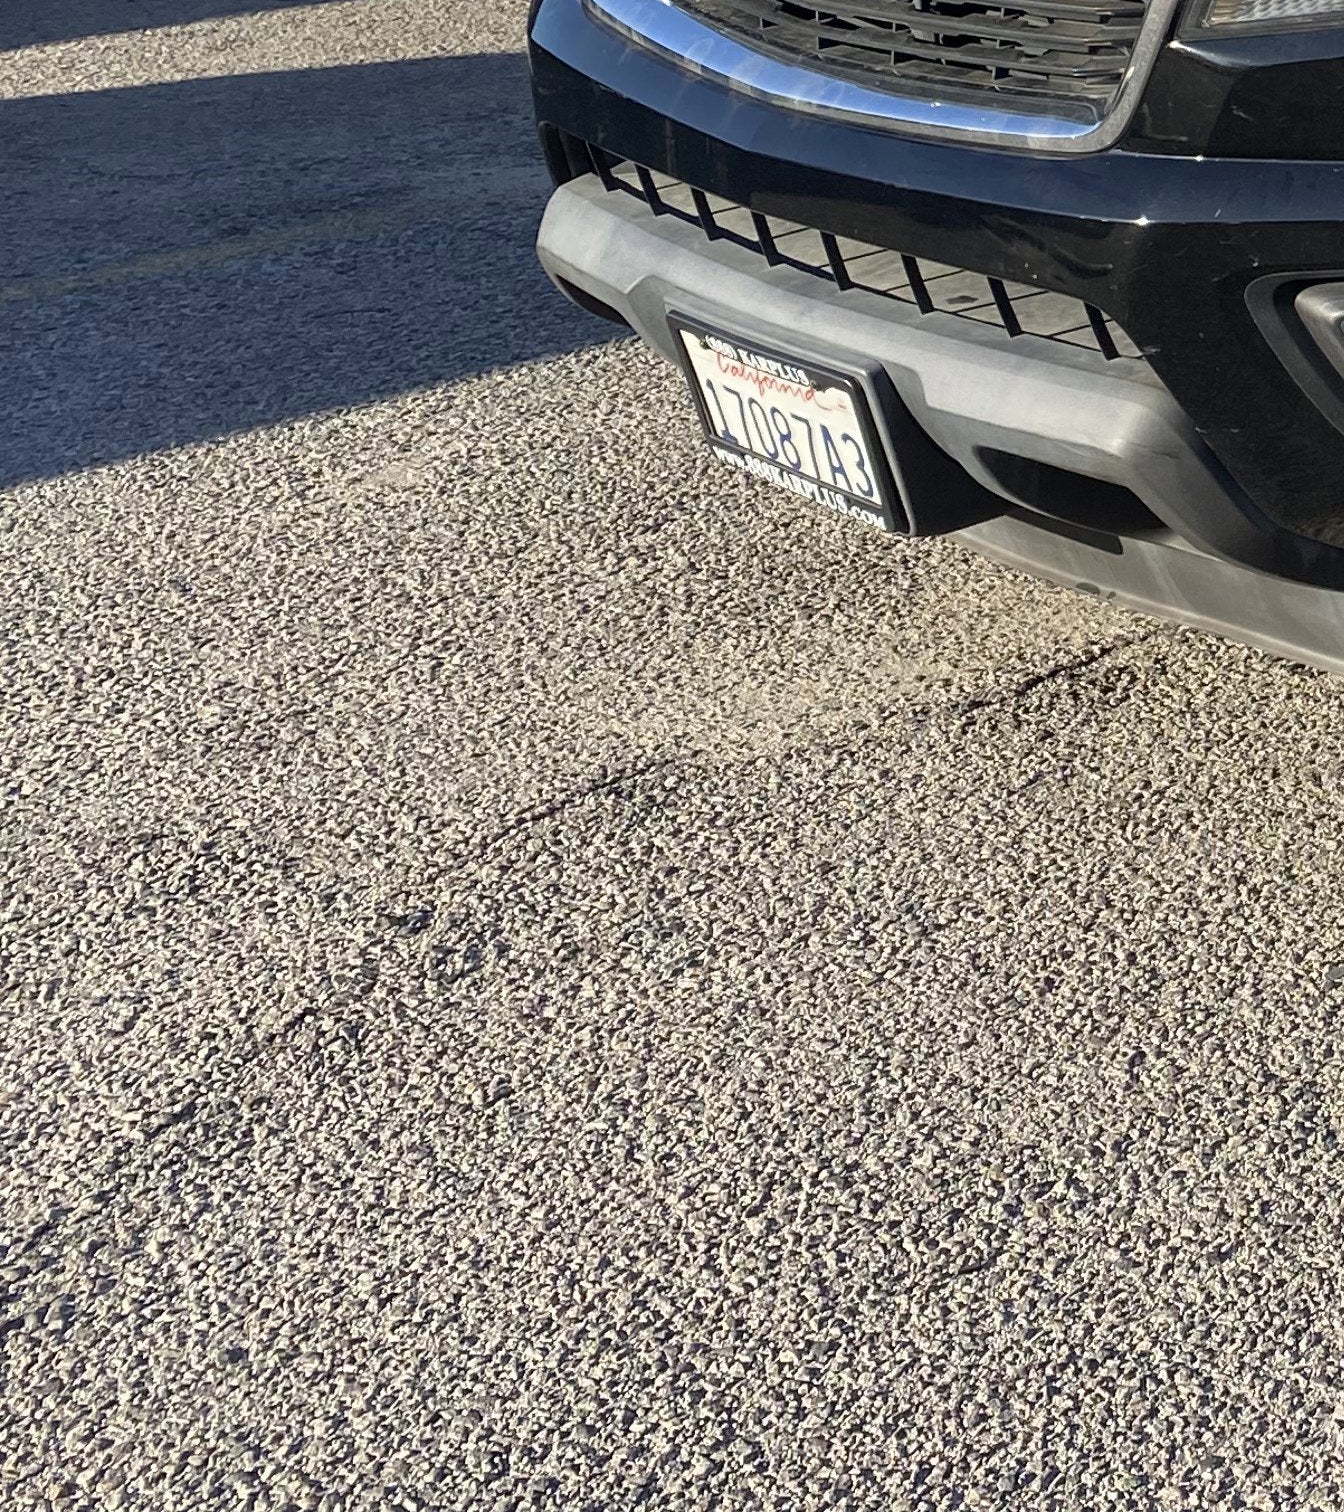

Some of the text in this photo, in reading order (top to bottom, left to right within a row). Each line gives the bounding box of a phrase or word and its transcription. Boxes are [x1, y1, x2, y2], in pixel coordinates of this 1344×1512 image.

[716, 352, 816, 404] California
[737, 347, 810, 387] KARPLUS
[705, 378, 874, 498] 17087A3
